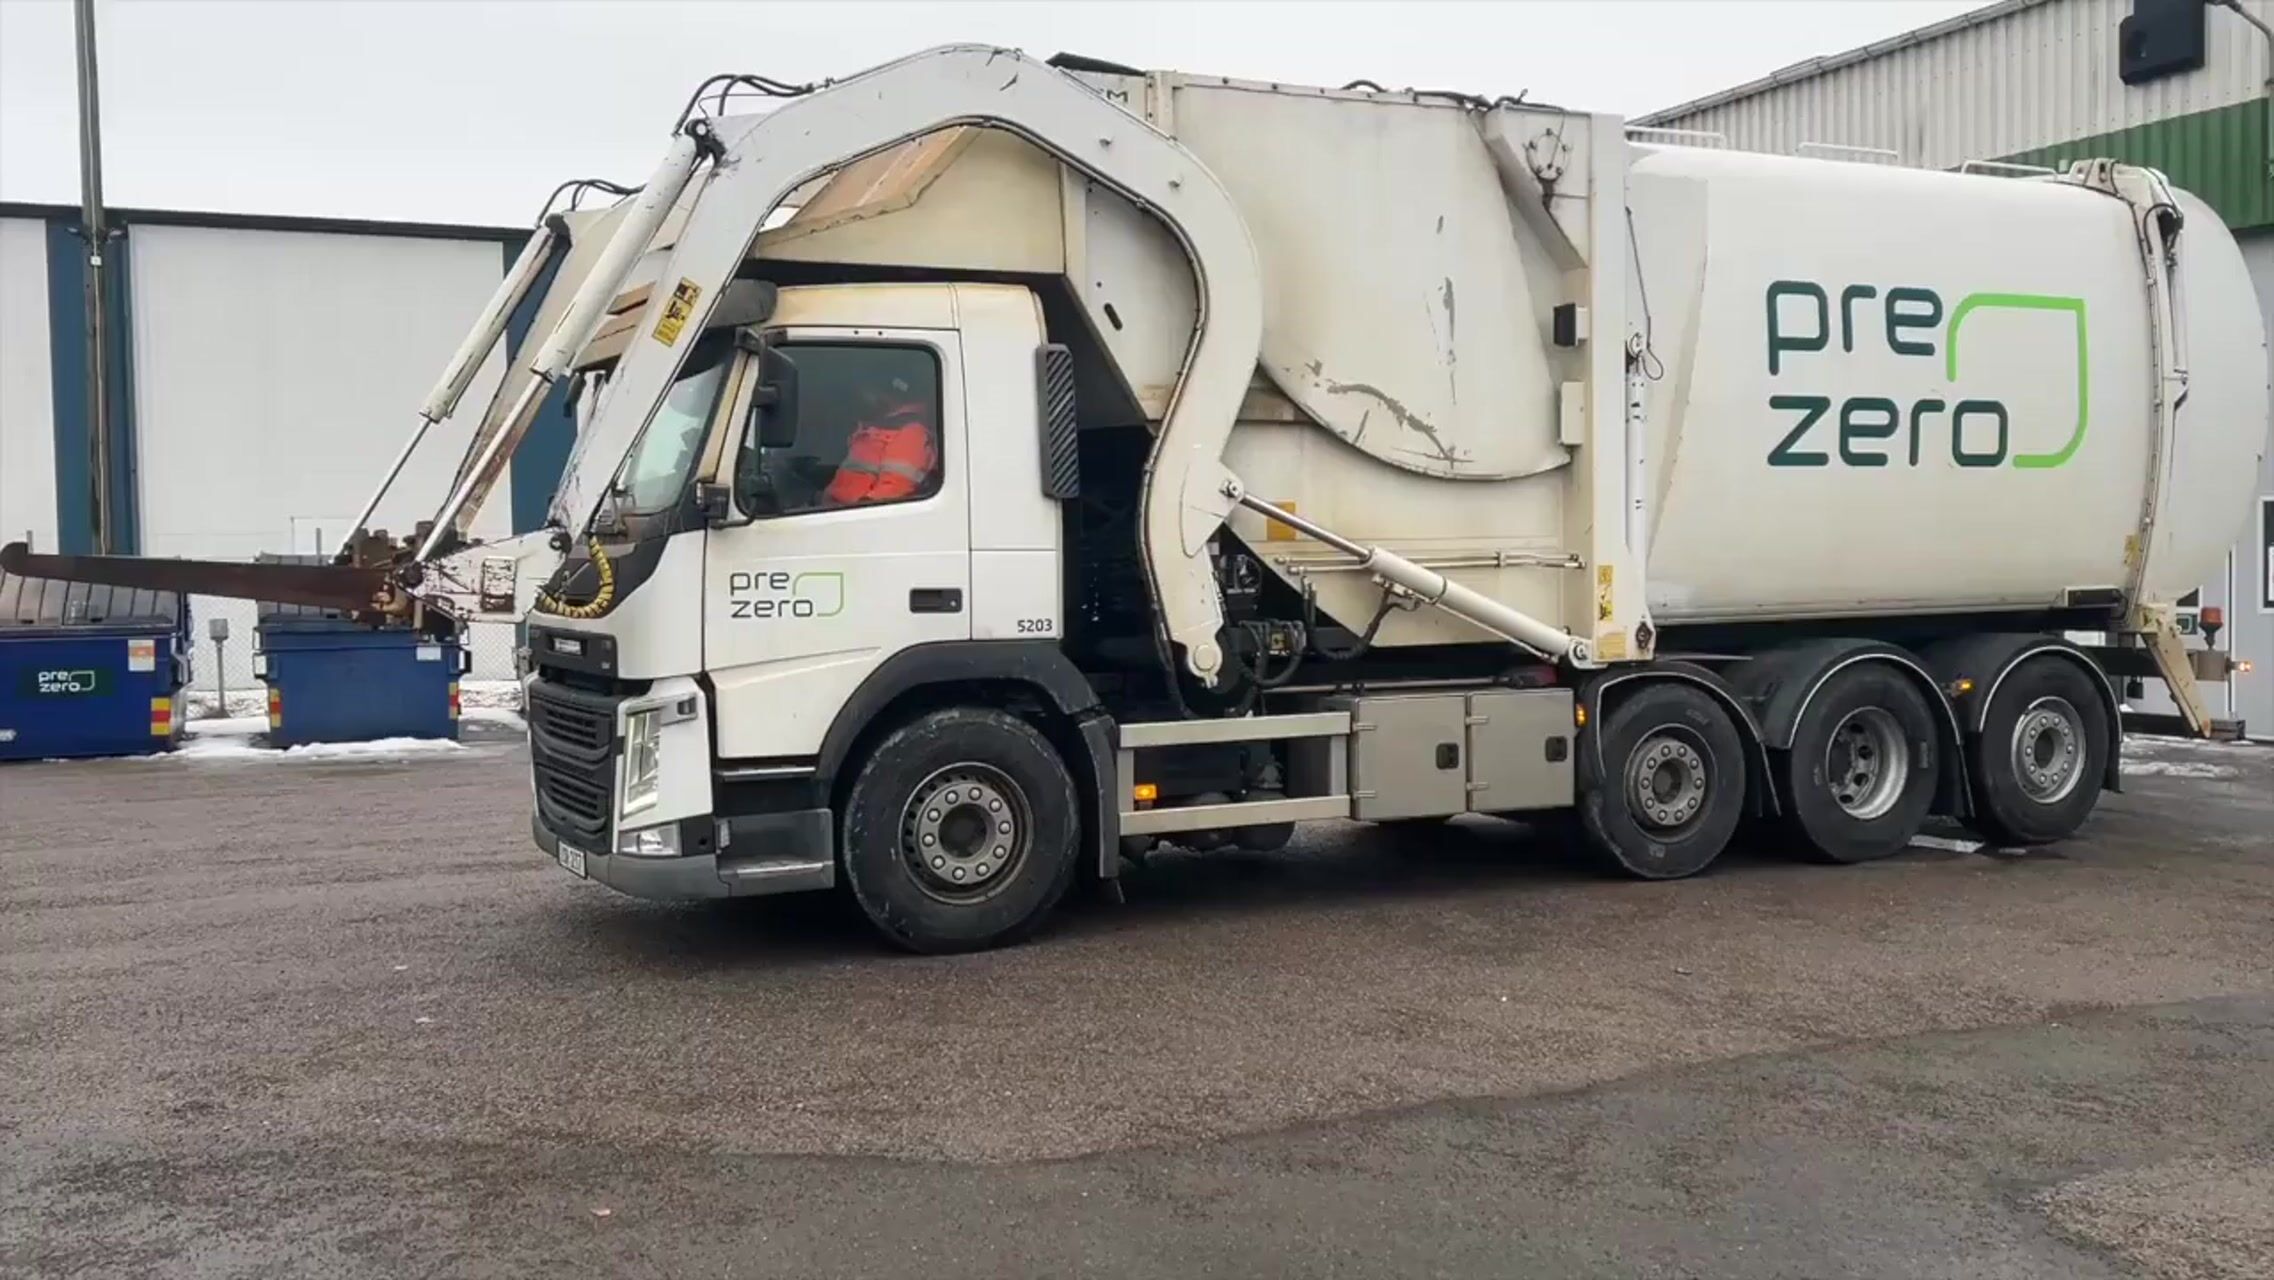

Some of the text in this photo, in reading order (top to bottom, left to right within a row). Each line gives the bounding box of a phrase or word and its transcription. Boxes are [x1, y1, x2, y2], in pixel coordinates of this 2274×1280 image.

[1766, 279, 1943, 376] pre
[1767, 395, 2008, 467] zero
[730, 572, 790, 596] pre
[731, 599, 813, 618] zero
[1017, 618, 1053, 633] 5203
[38, 671, 68, 682] pre
[39, 682, 81, 692] zero
